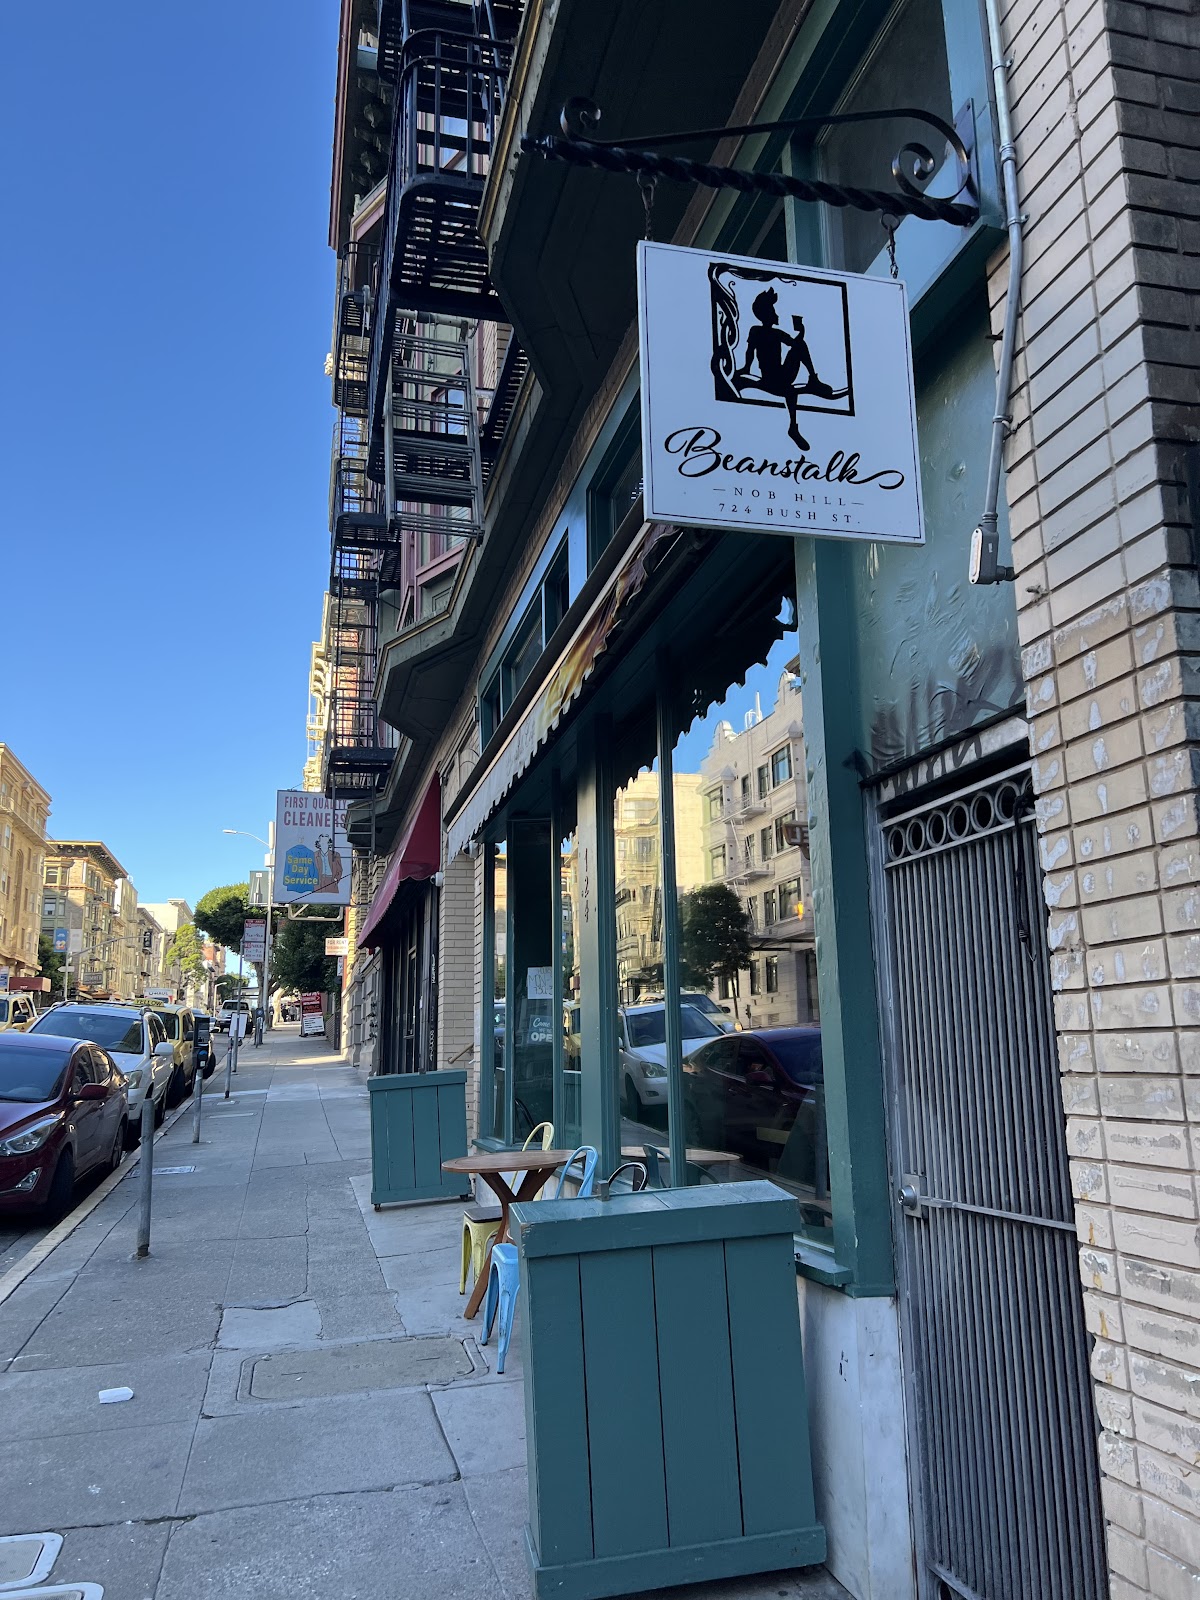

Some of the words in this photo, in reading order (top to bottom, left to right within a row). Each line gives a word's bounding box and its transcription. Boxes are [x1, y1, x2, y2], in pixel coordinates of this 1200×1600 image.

[664, 426, 905, 490] Beanstalk
[734, 487, 776, 500] NOB
[795, 493, 846, 506] HILL
[719, 503, 752, 514] 724
[767, 507, 817, 520] BUSH
[832, 513, 861, 524] ST.
[284, 796, 308, 809] FIRST
[283, 810, 346, 828] CLEANERS
[287, 855, 313, 864] Same
[291, 864, 309, 875] Day
[284, 875, 318, 885] Service
[136, 999, 163, 1007] YELLOW
[533, 1017, 551, 1028] Come
[531, 1031, 553, 1043] OPE
